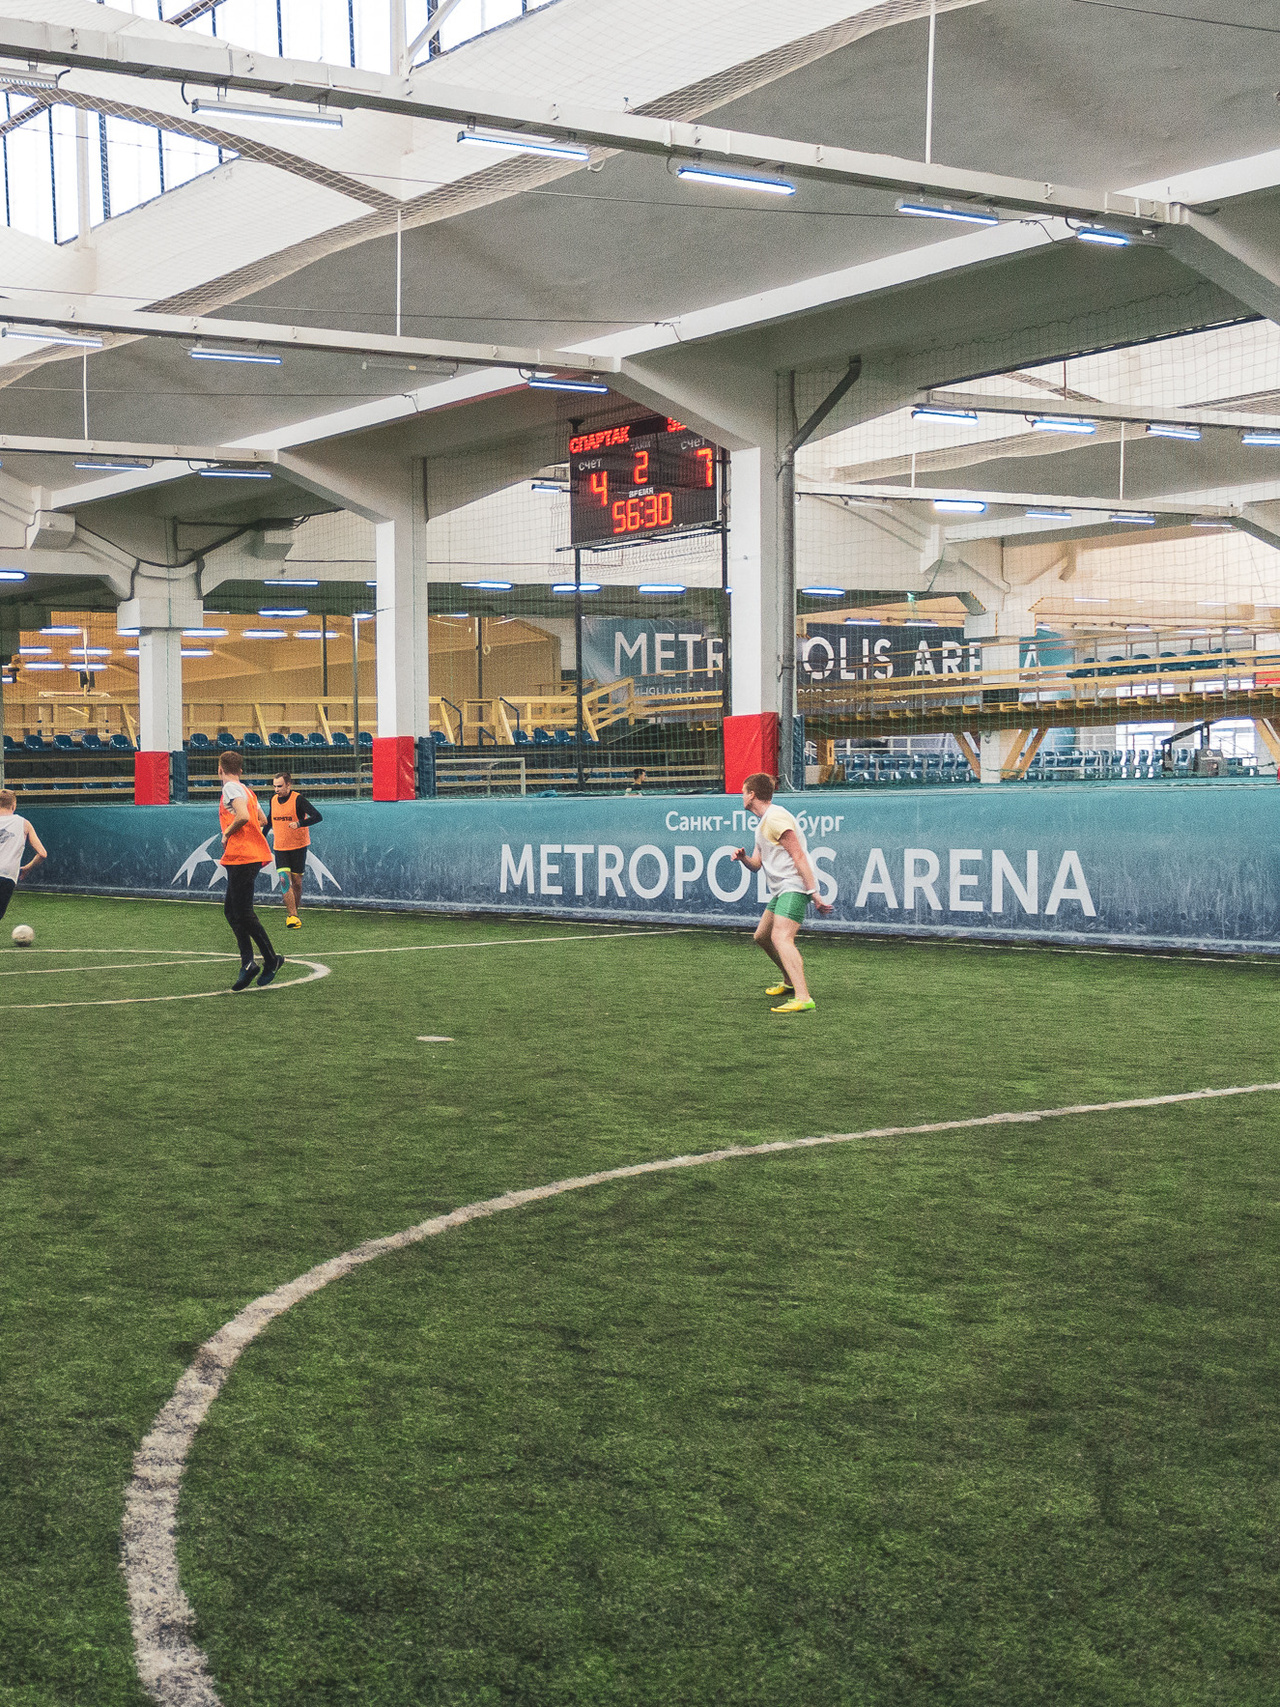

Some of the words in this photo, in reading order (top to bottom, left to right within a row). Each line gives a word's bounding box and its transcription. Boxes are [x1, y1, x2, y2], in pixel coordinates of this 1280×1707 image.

[569, 426, 630, 454] СПАРТАК
[634, 450, 649, 485] 2
[696, 447, 713, 487] 7
[591, 471, 608, 507] 4
[612, 492, 673, 534] 56:30
[910, 640, 1042, 681] AREA
[665, 810, 845, 837] Санкт-Пебург
[854, 848, 1097, 917] ARENA
